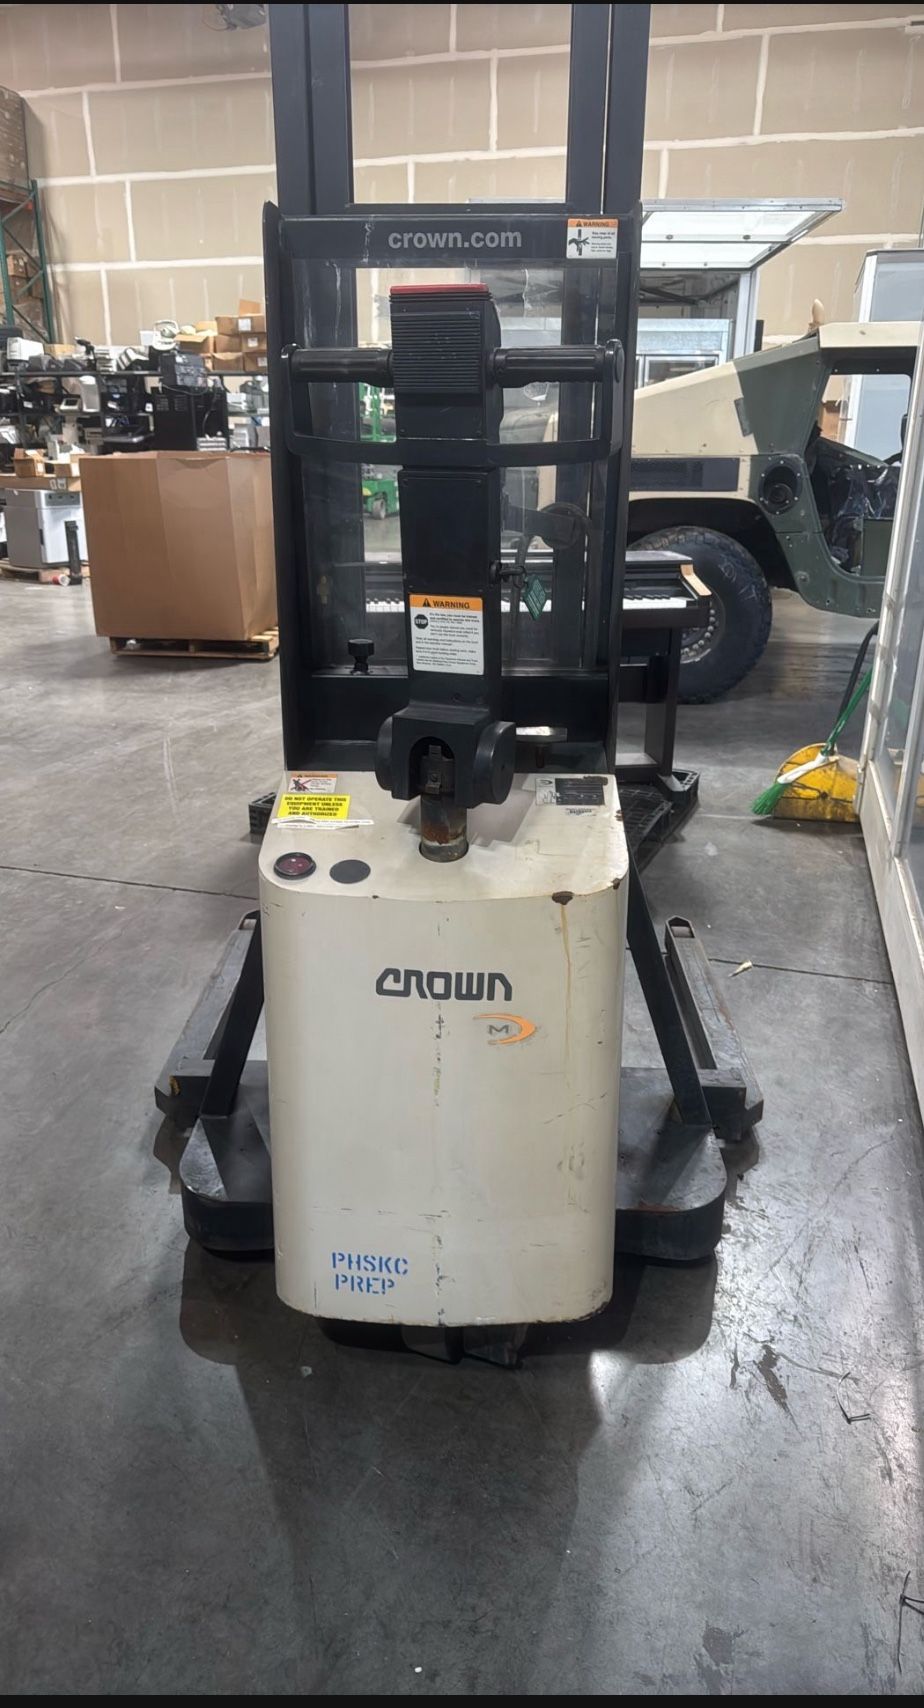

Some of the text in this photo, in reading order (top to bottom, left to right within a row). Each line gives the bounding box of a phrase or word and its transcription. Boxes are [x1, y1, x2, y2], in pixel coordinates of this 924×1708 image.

[388, 231, 522, 248] crown.com
[432, 600, 470, 609] WARNING
[375, 967, 513, 1001] CROWN
[332, 1252, 408, 1275] PHSKC
[335, 1273, 395, 1295] PREP
